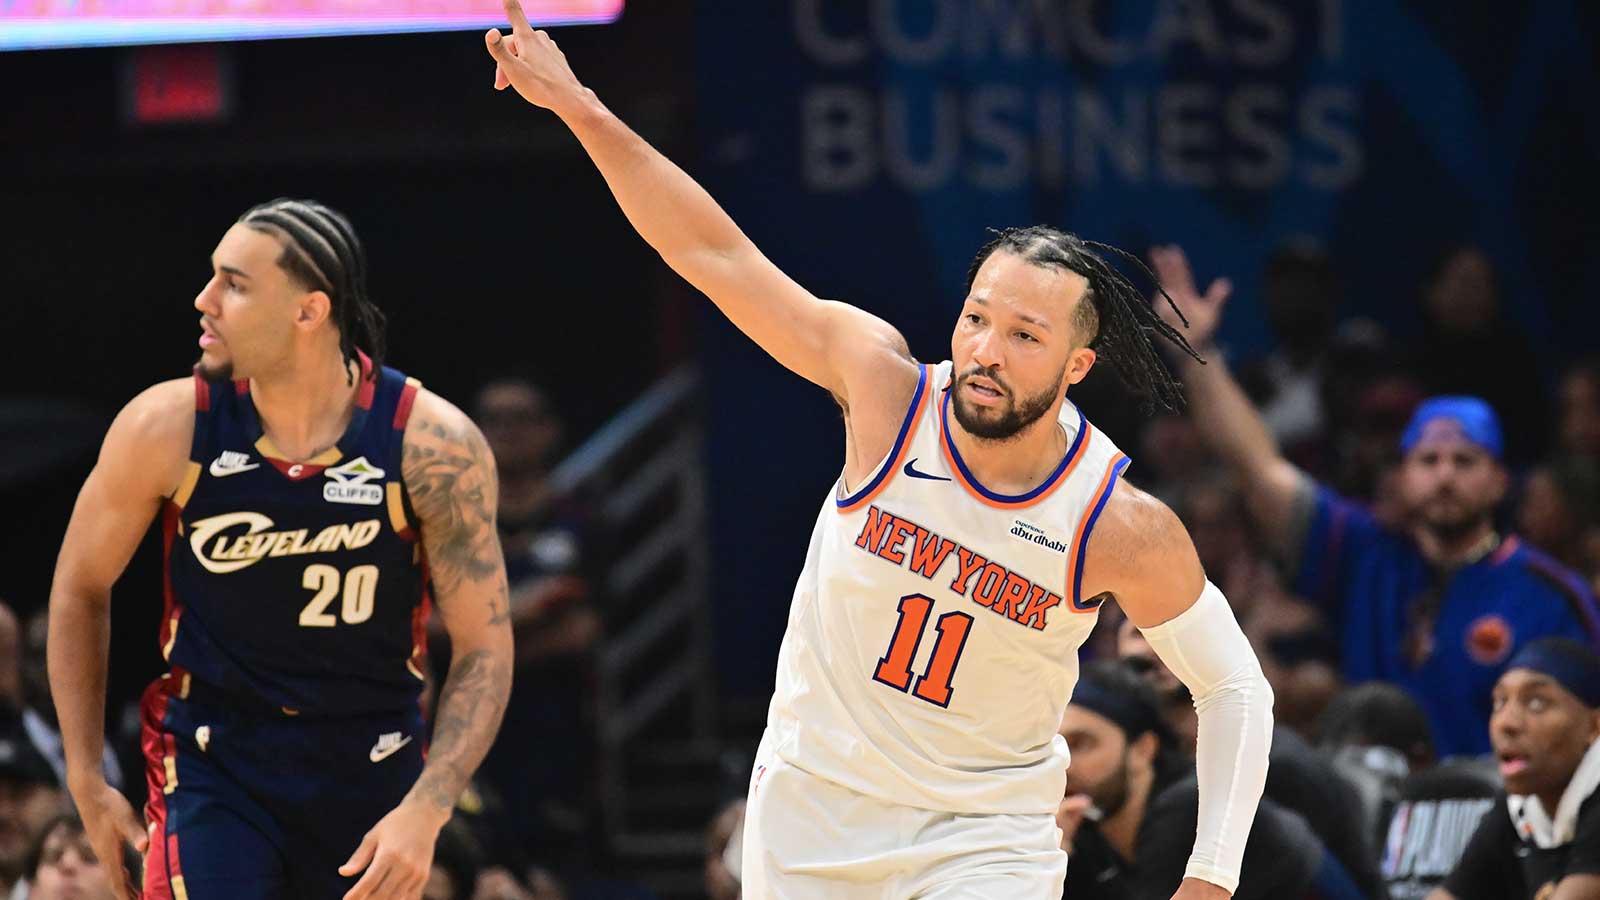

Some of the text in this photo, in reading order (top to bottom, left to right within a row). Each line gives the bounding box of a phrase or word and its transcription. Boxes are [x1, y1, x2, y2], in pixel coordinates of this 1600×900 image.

[801, 86, 1364, 191] BUSINESS
[326, 487, 380, 500] CLIFFS
[190, 511, 381, 574] CLEVELAND
[855, 504, 1064, 632] NEW YORK
[1010, 526, 1067, 553] abu dhabi
[299, 564, 380, 627] 20
[872, 593, 975, 709] 11
